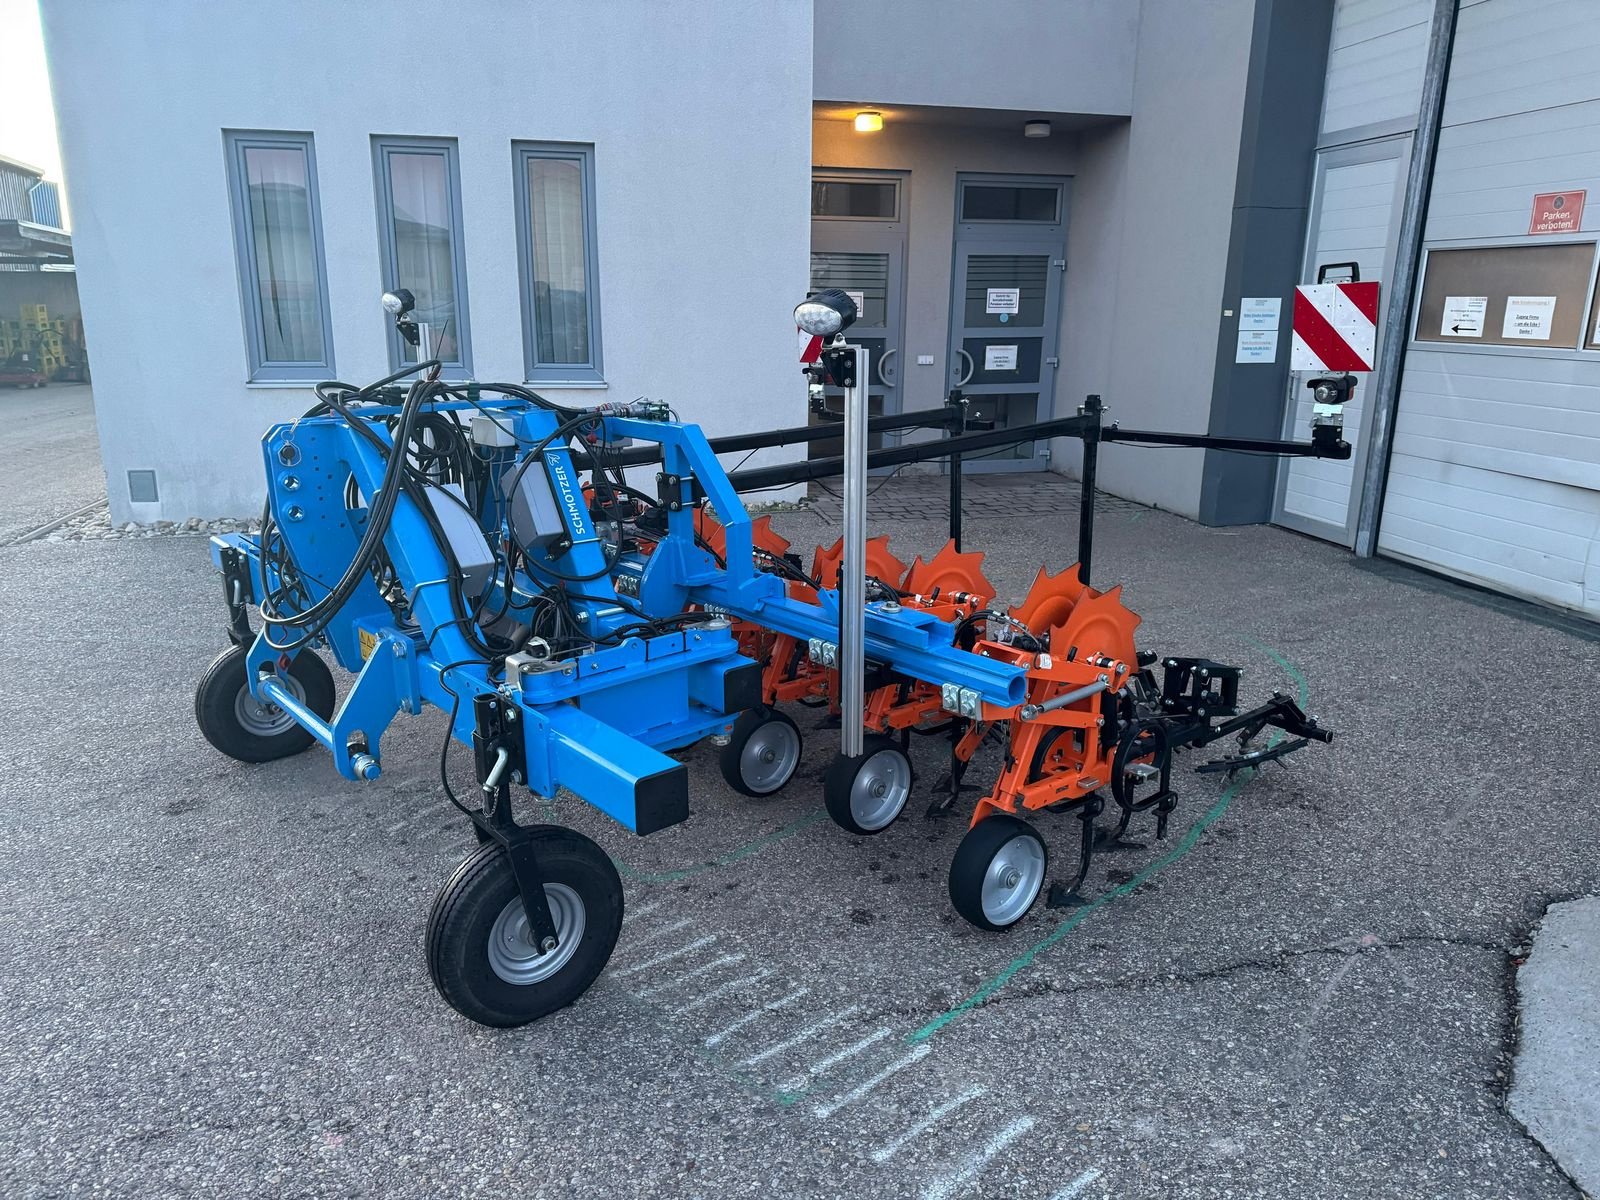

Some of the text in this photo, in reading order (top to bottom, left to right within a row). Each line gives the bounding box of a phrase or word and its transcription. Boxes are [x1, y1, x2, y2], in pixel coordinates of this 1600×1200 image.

[1542, 211, 1570, 220] Parken
[1536, 220, 1574, 230] verboten!
[555, 465, 586, 535] SCHMOTZER
